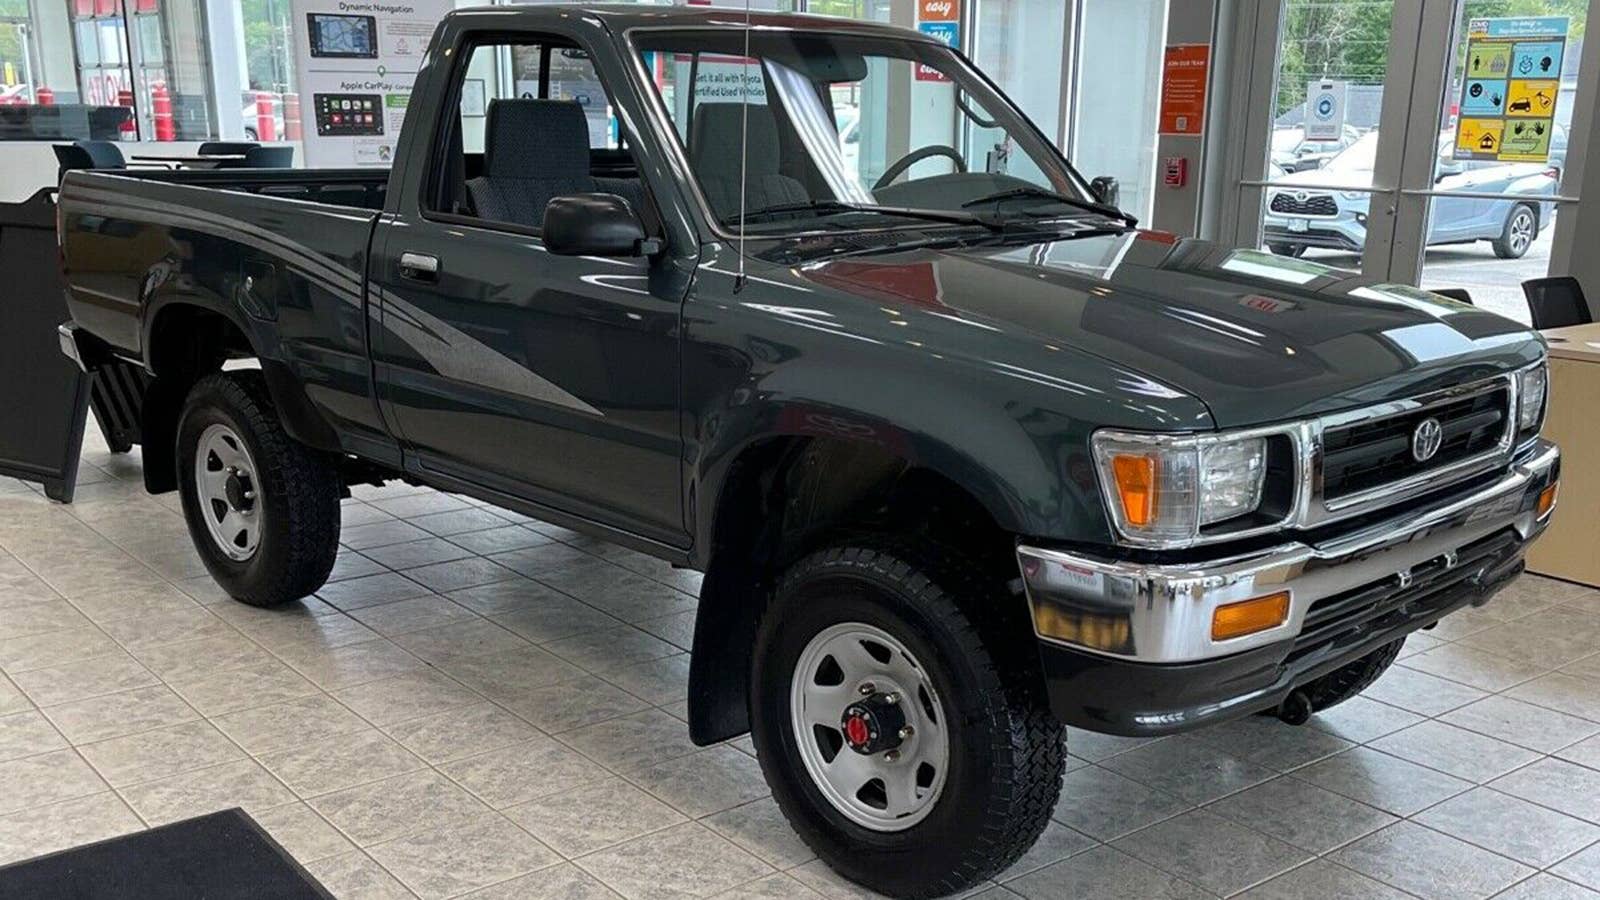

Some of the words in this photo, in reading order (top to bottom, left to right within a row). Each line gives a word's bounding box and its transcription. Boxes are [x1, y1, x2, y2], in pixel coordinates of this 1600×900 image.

[339, 2, 373, 12] Dynamic
[373, 3, 415, 14] Navigation
[925, 2, 952, 17] easy
[724, 73, 739, 83] with
[341, 82, 363, 90] Apple
[364, 82, 393, 91] CarPlay
[694, 87, 720, 96] ertified
[720, 87, 738, 96] Used
